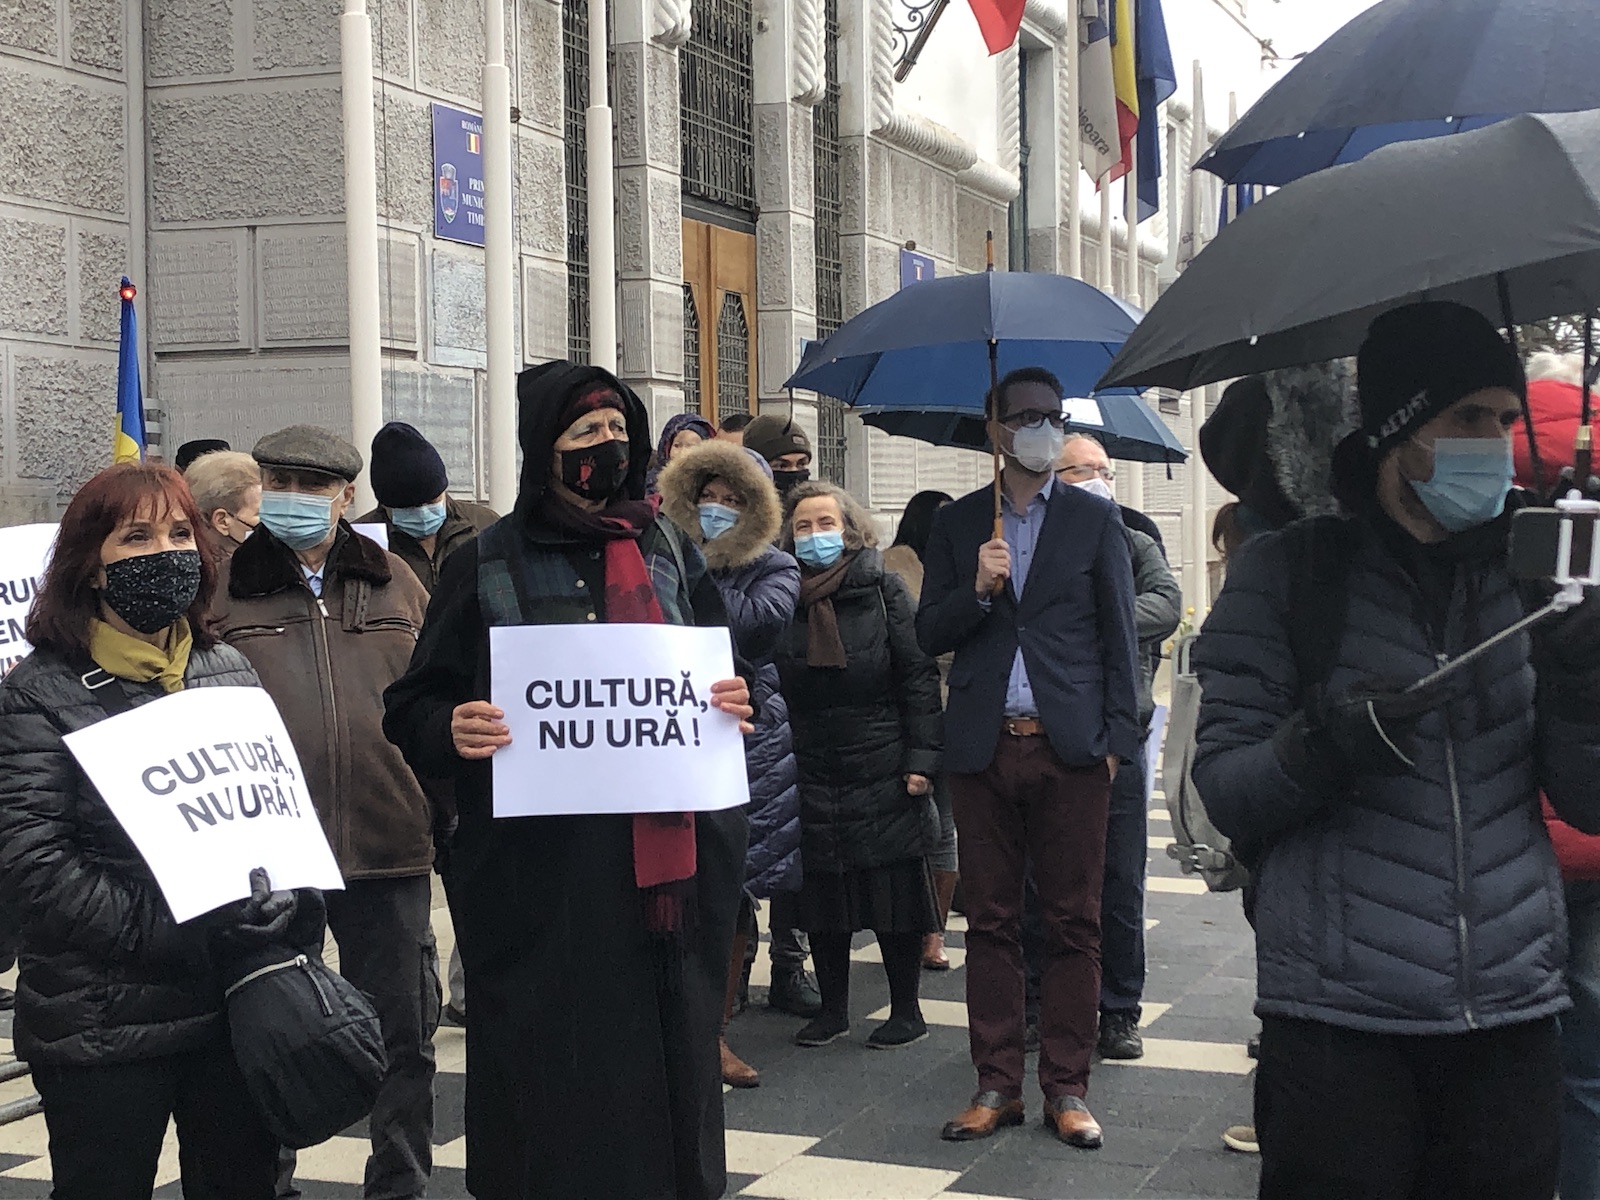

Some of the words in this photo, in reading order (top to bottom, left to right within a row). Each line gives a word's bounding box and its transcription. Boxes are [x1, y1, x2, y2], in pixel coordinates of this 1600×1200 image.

[525, 670, 708, 713] CULTURĂ,
[539, 719, 594, 750] NU
[606, 709, 686, 748] URĂ
[692, 717, 701, 747] !
[141, 735, 295, 796] CULTURĂ,
[176, 787, 234, 833] NU
